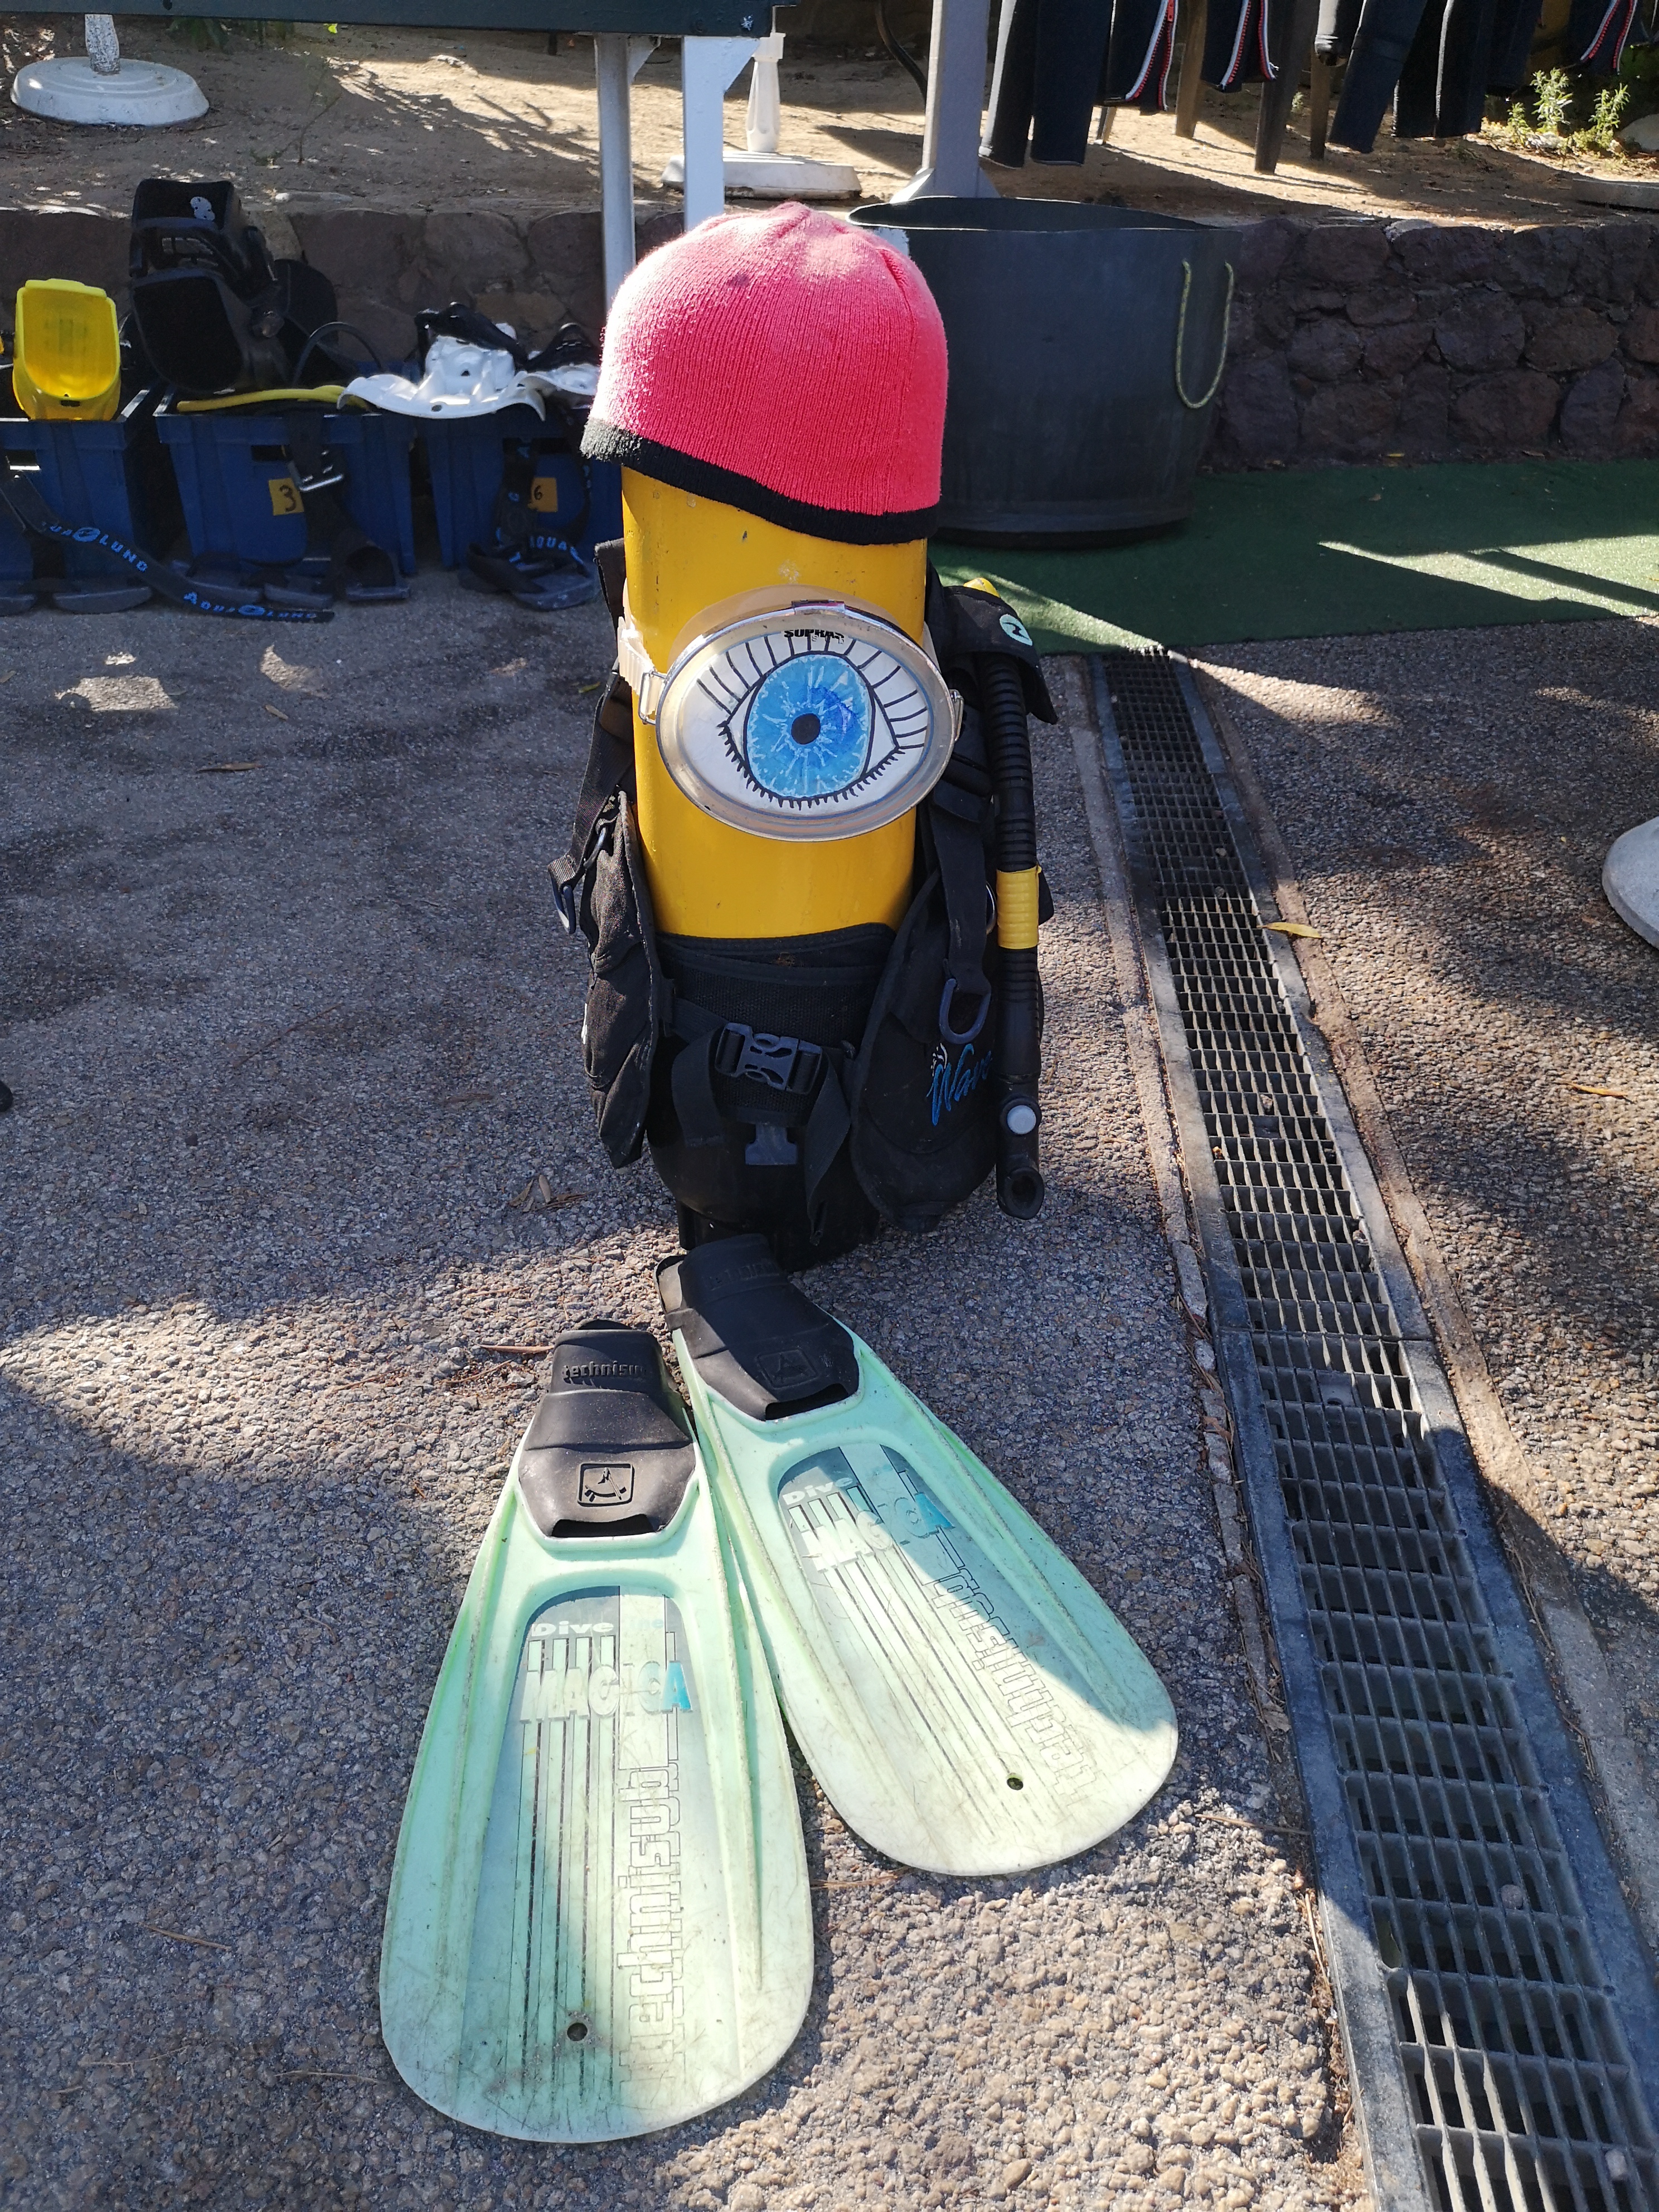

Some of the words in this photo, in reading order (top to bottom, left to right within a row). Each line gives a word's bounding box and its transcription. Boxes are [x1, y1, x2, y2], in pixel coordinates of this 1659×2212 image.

[279, 485, 296, 512] 3
[533, 485, 543, 501] 6
[99, 533, 148, 572] LUNG
[782, 1477, 853, 1506] Dive
[531, 1620, 614, 1637] Dive
